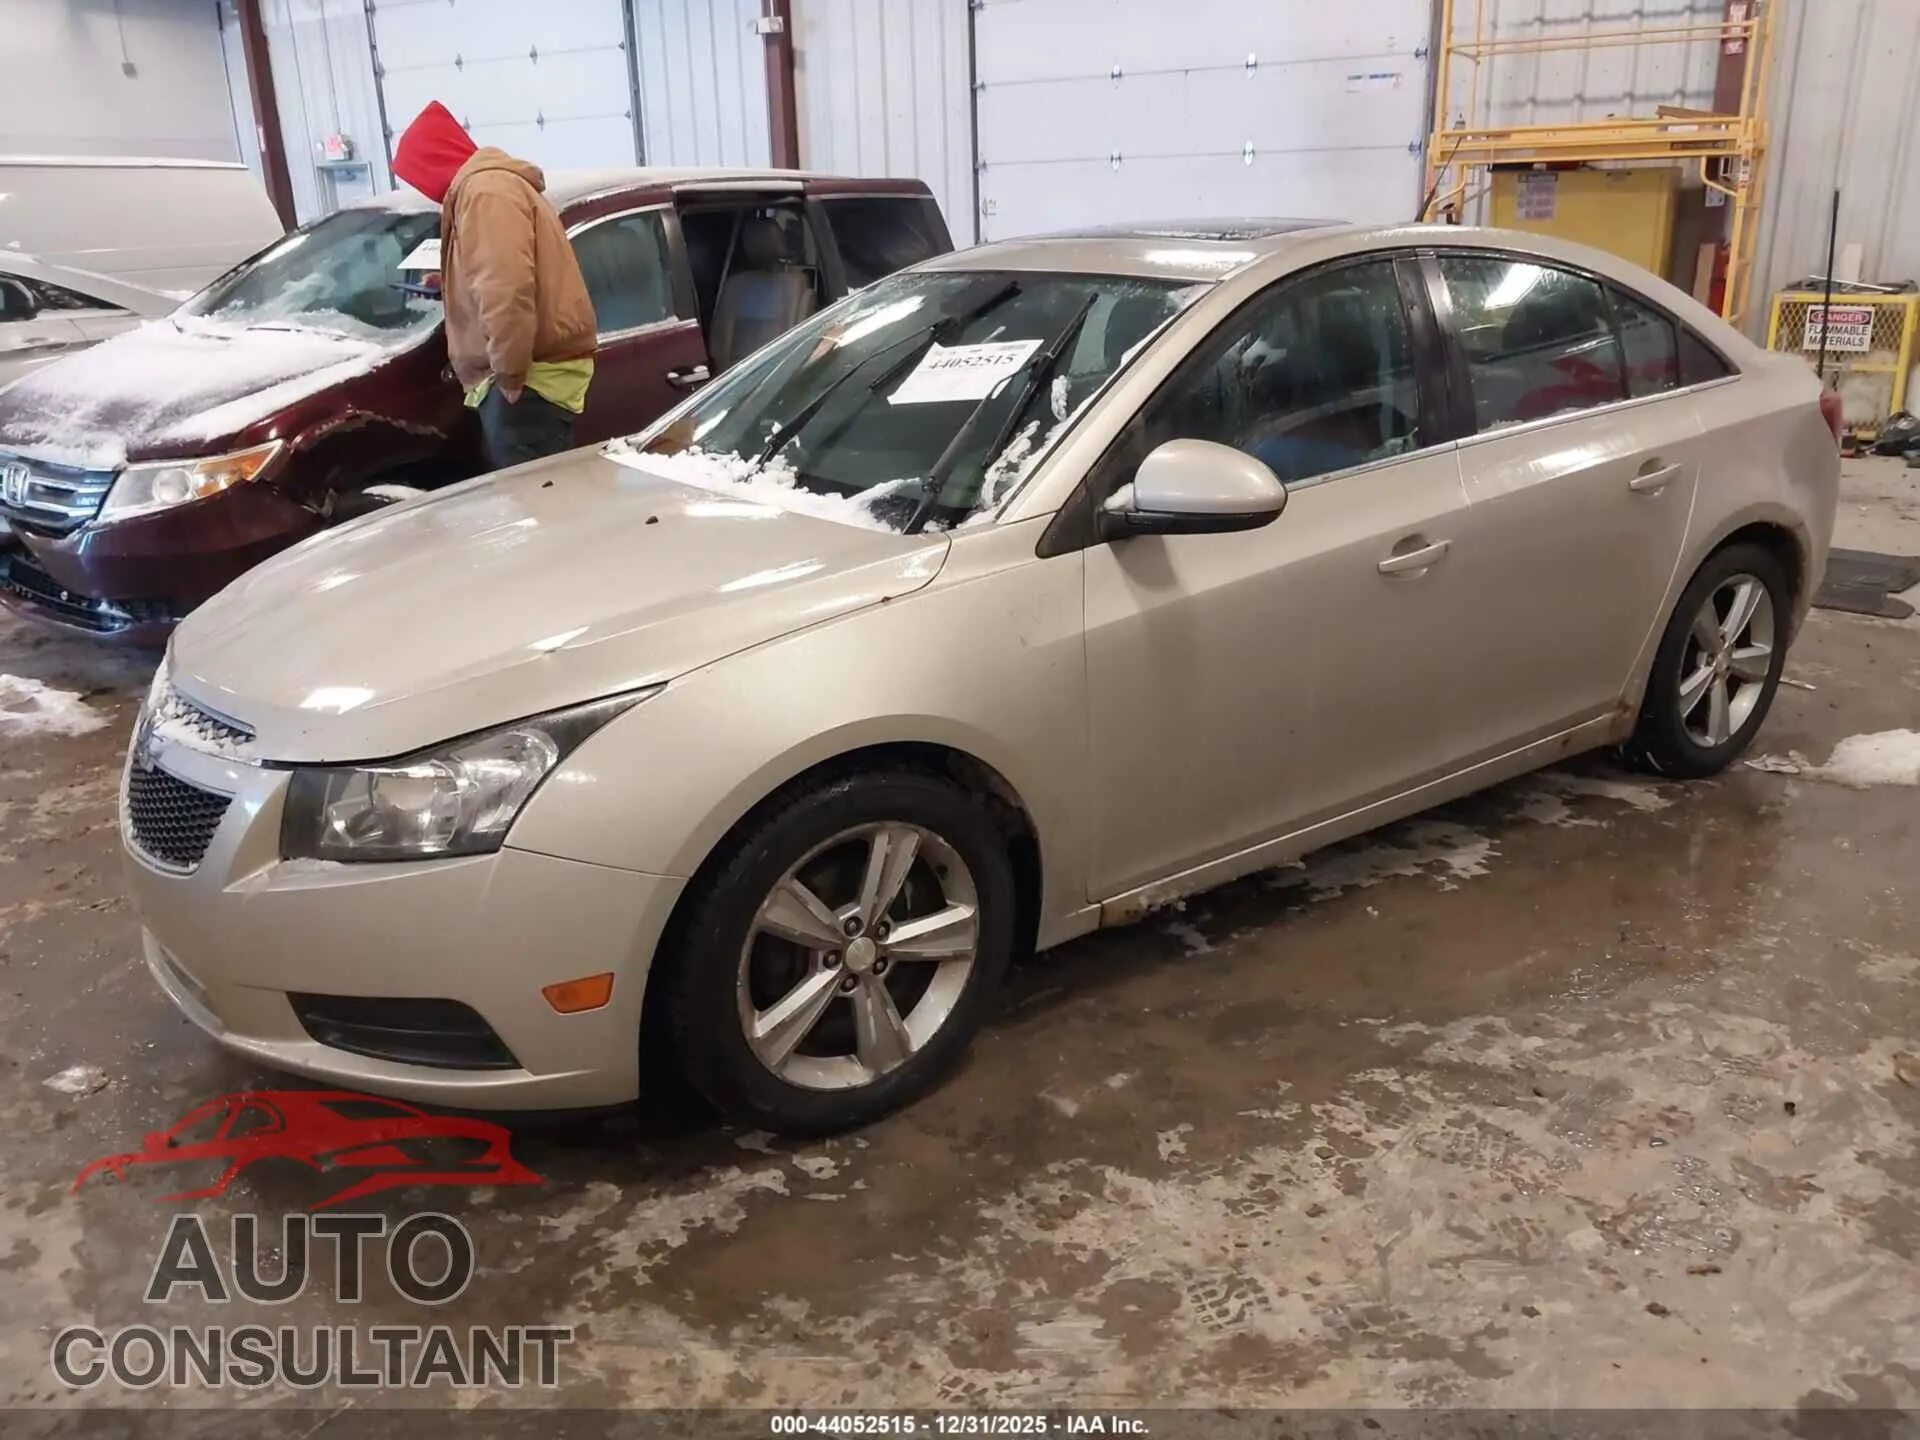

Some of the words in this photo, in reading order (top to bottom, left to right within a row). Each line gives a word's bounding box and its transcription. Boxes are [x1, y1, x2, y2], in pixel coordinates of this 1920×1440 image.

[1818, 312, 1863, 322] DANGER
[1809, 325, 1868, 336] FLAMMABLE
[1809, 336, 1864, 346] MATERIALS
[930, 354, 1016, 369] 44052515
